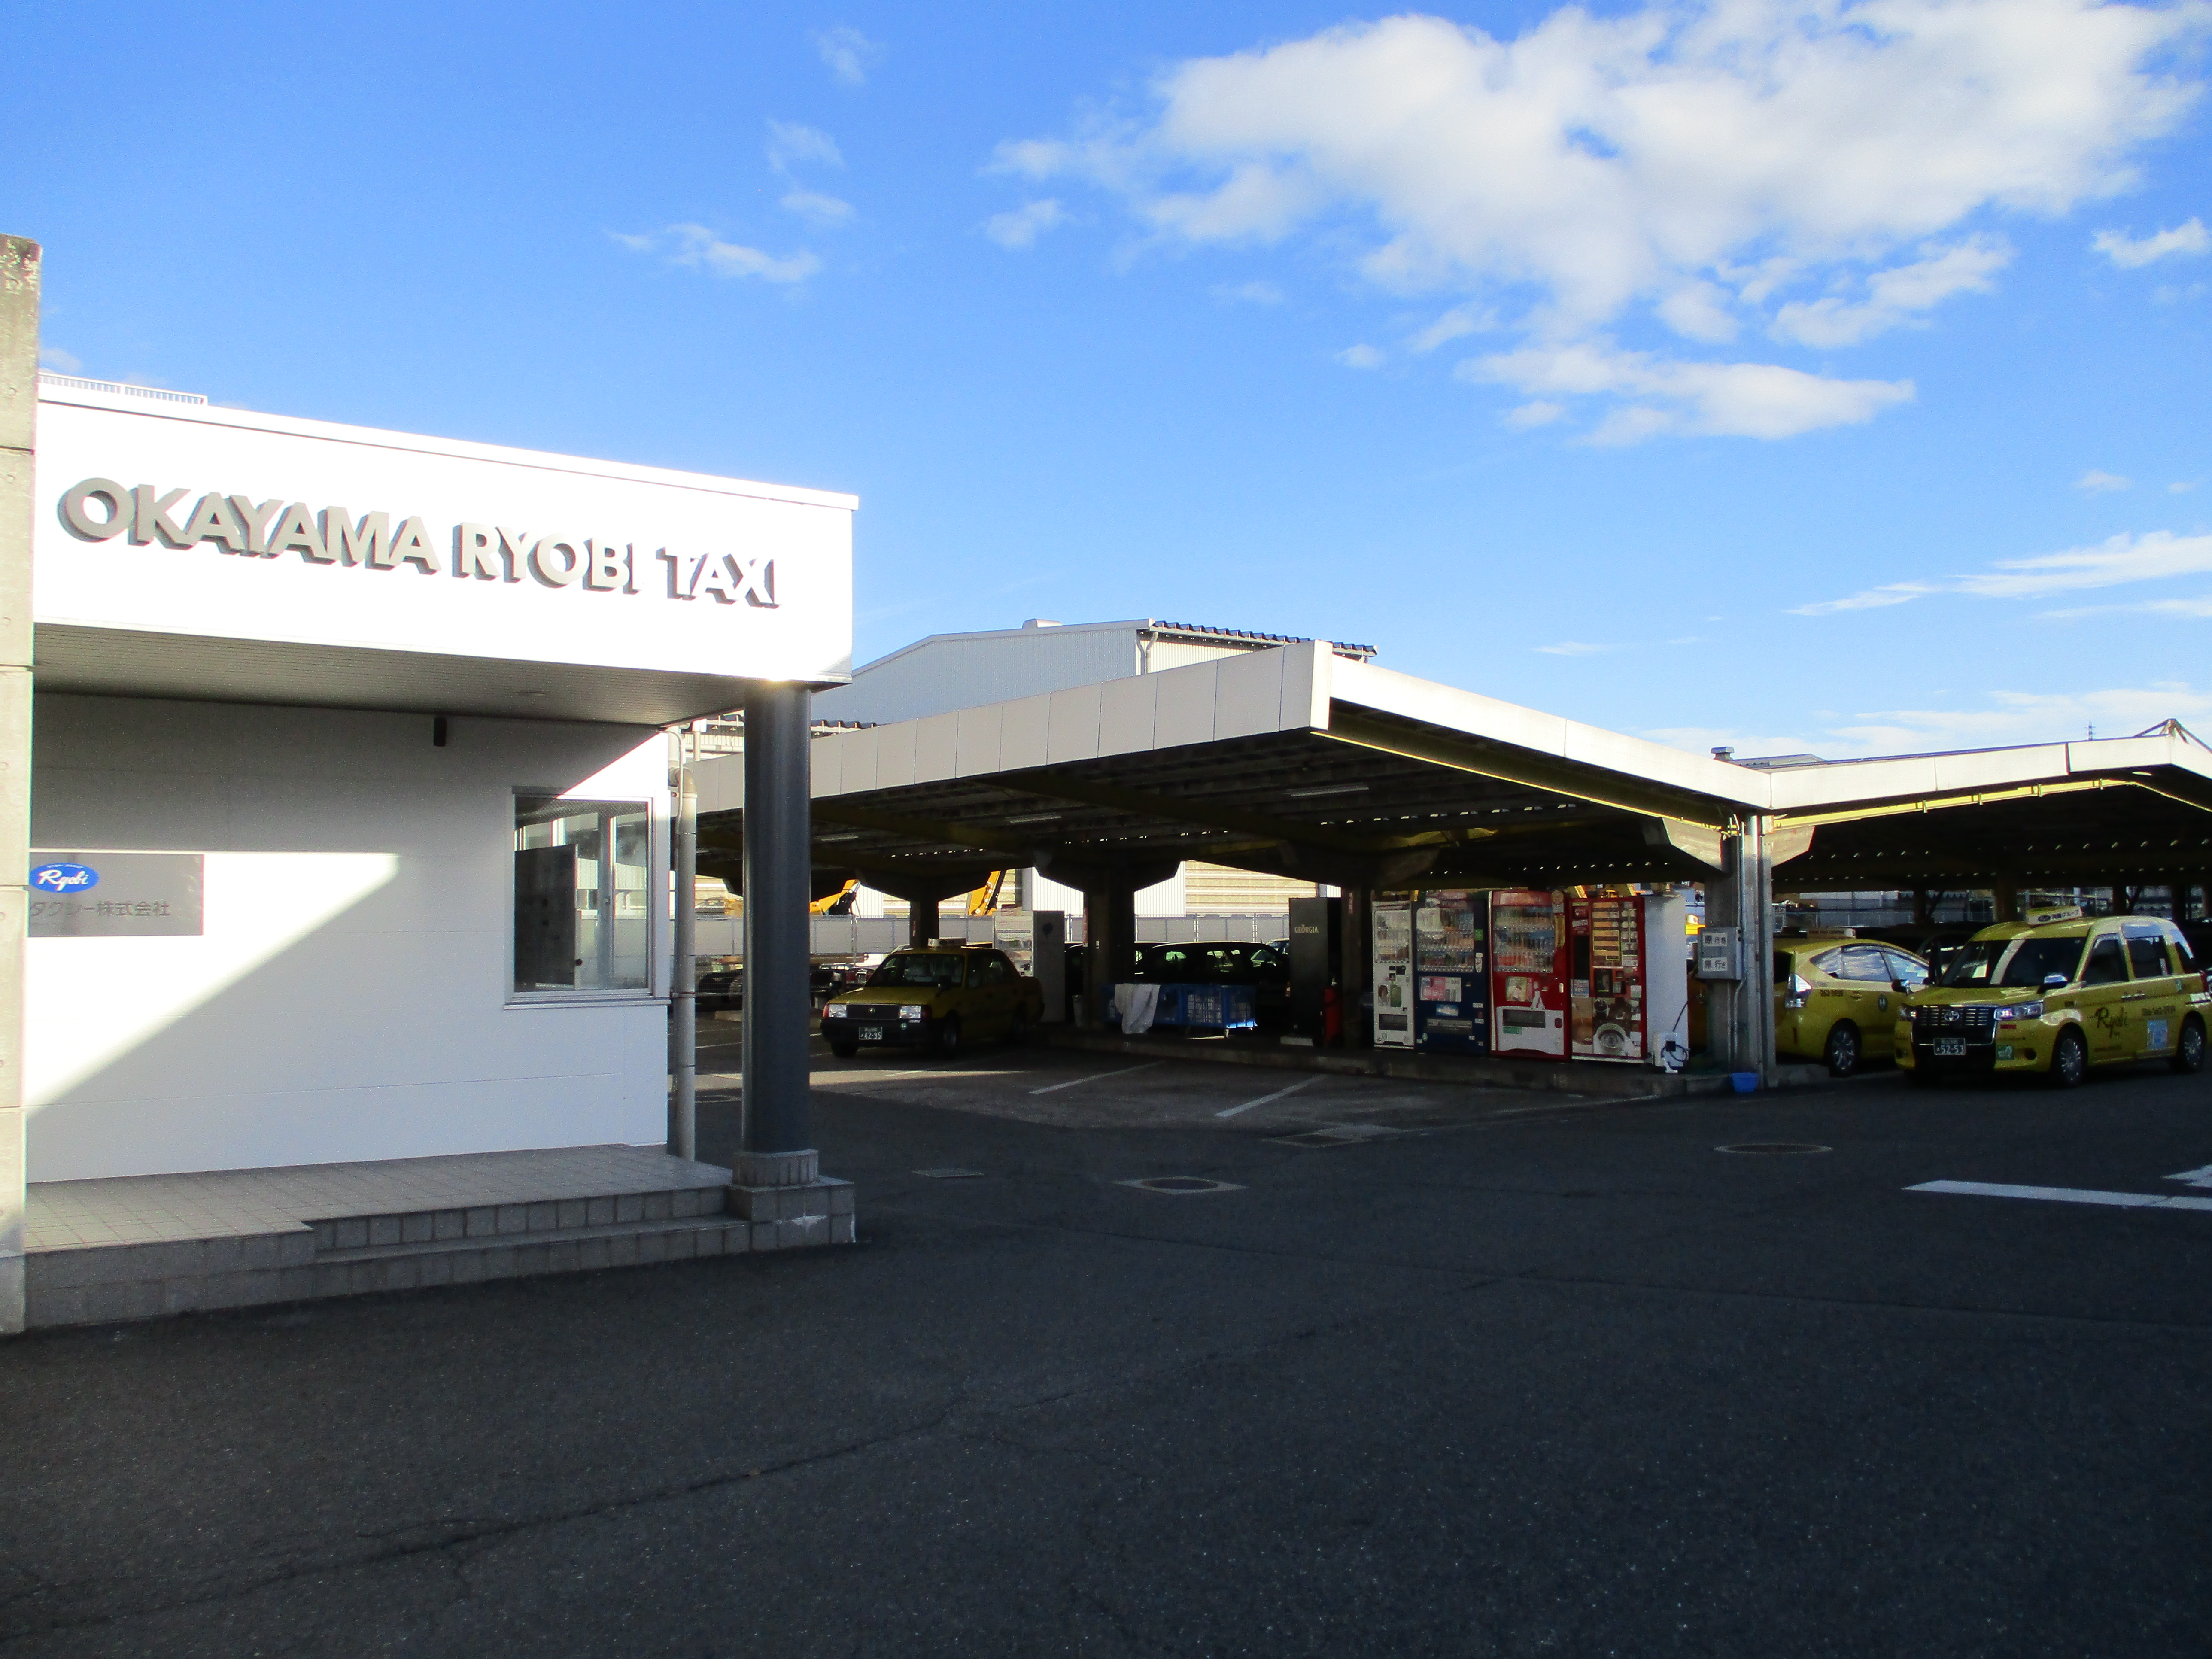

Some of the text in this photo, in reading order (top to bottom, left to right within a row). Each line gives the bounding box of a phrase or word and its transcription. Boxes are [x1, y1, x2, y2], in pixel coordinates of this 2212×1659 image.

[57, 477, 780, 609] OKAYAMA RYOBI TAXI
[38, 869, 88, 891] Ryobi
[1294, 924, 1319, 933] GEORGIA
